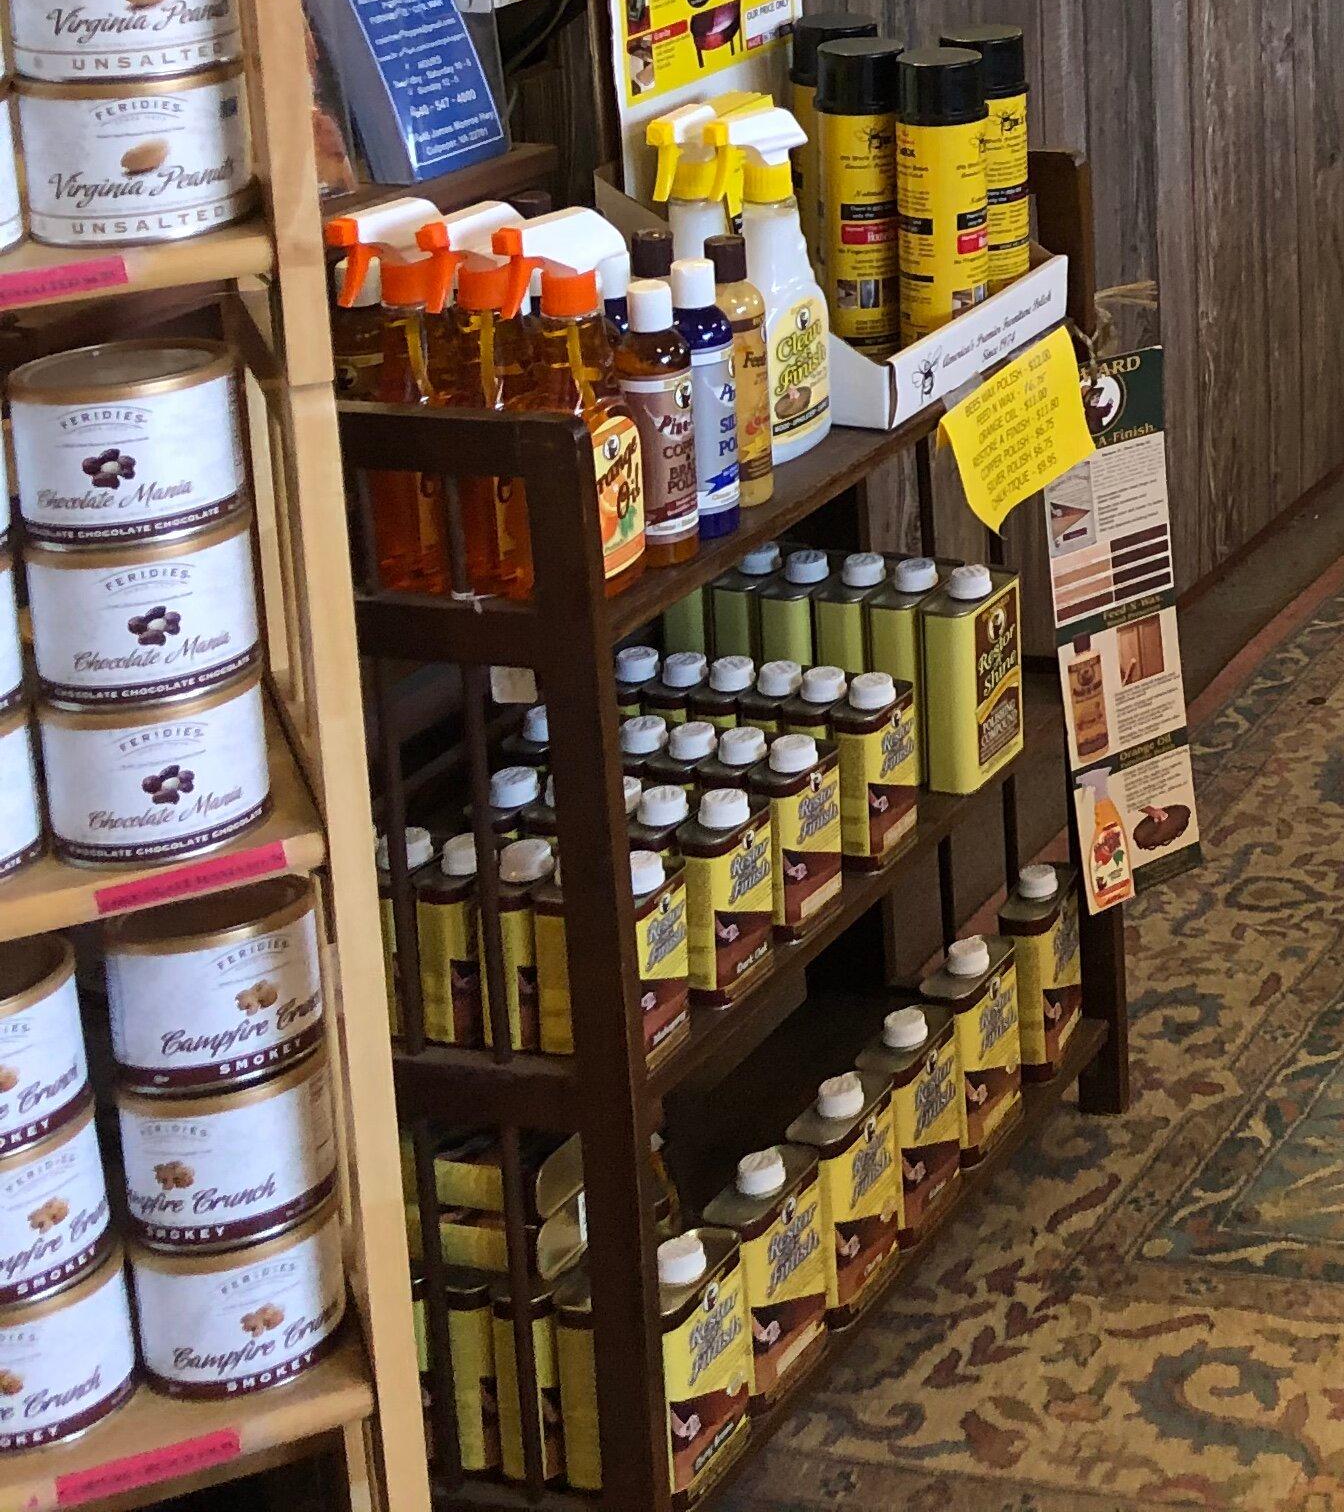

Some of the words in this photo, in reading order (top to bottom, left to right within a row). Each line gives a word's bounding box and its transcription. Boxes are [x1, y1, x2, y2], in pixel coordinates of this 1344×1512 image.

[46, 6, 148, 44] Virginia
[746, 9, 759, 21] OUR
[759, 4, 775, 16] PRICE
[95, 99, 185, 121] FERIDIES
[49, 171, 144, 208] Virginia
[72, 205, 225, 235] UNSALTED
[942, 339, 977, 369] America's
[1031, 288, 1052, 315] Polish
[982, 345, 999, 364] Since
[999, 330, 1017, 354] 1974
[964, 396, 982, 419] BEES
[995, 367, 1024, 394] POLISH
[60, 410, 148, 430] FERIDIES
[978, 420, 1004, 445] ORANGE
[1023, 386, 1048, 410] $11.00
[1003, 436, 1030, 464] POLISH
[1007, 451, 1033, 479] POLISH
[36, 488, 115, 511] Chocolate
[118, 479, 193, 509] Mania
[616, 462, 641, 520] Oil
[77, 524, 151, 540] CHOCOLATE
[154, 506, 220, 531] CHOCOLATE
[105, 567, 192, 591] FERIDIES
[73, 648, 159, 673] Chocolate
[164, 631, 231, 664] Mania
[121, 676, 196, 698] CHOCOLATE
[119, 727, 205, 753] FERIDIES
[88, 805, 175, 831] Chocolate
[798, 785, 835, 820] Restor
[796, 802, 838, 845] Finish
[136, 833, 210, 856] CHOCOLATE
[730, 837, 768, 876] Restor
[728, 862, 770, 905] Finish
[160, 1018, 270, 1059] Campfire
[219, 1038, 302, 1075] SMOKEY
[192, 1171, 276, 1215] Crunch
[16, 1244, 98, 1296] SMOKEY
[172, 1338, 276, 1376] Campfire
[226, 1351, 314, 1393] SMOKEY
